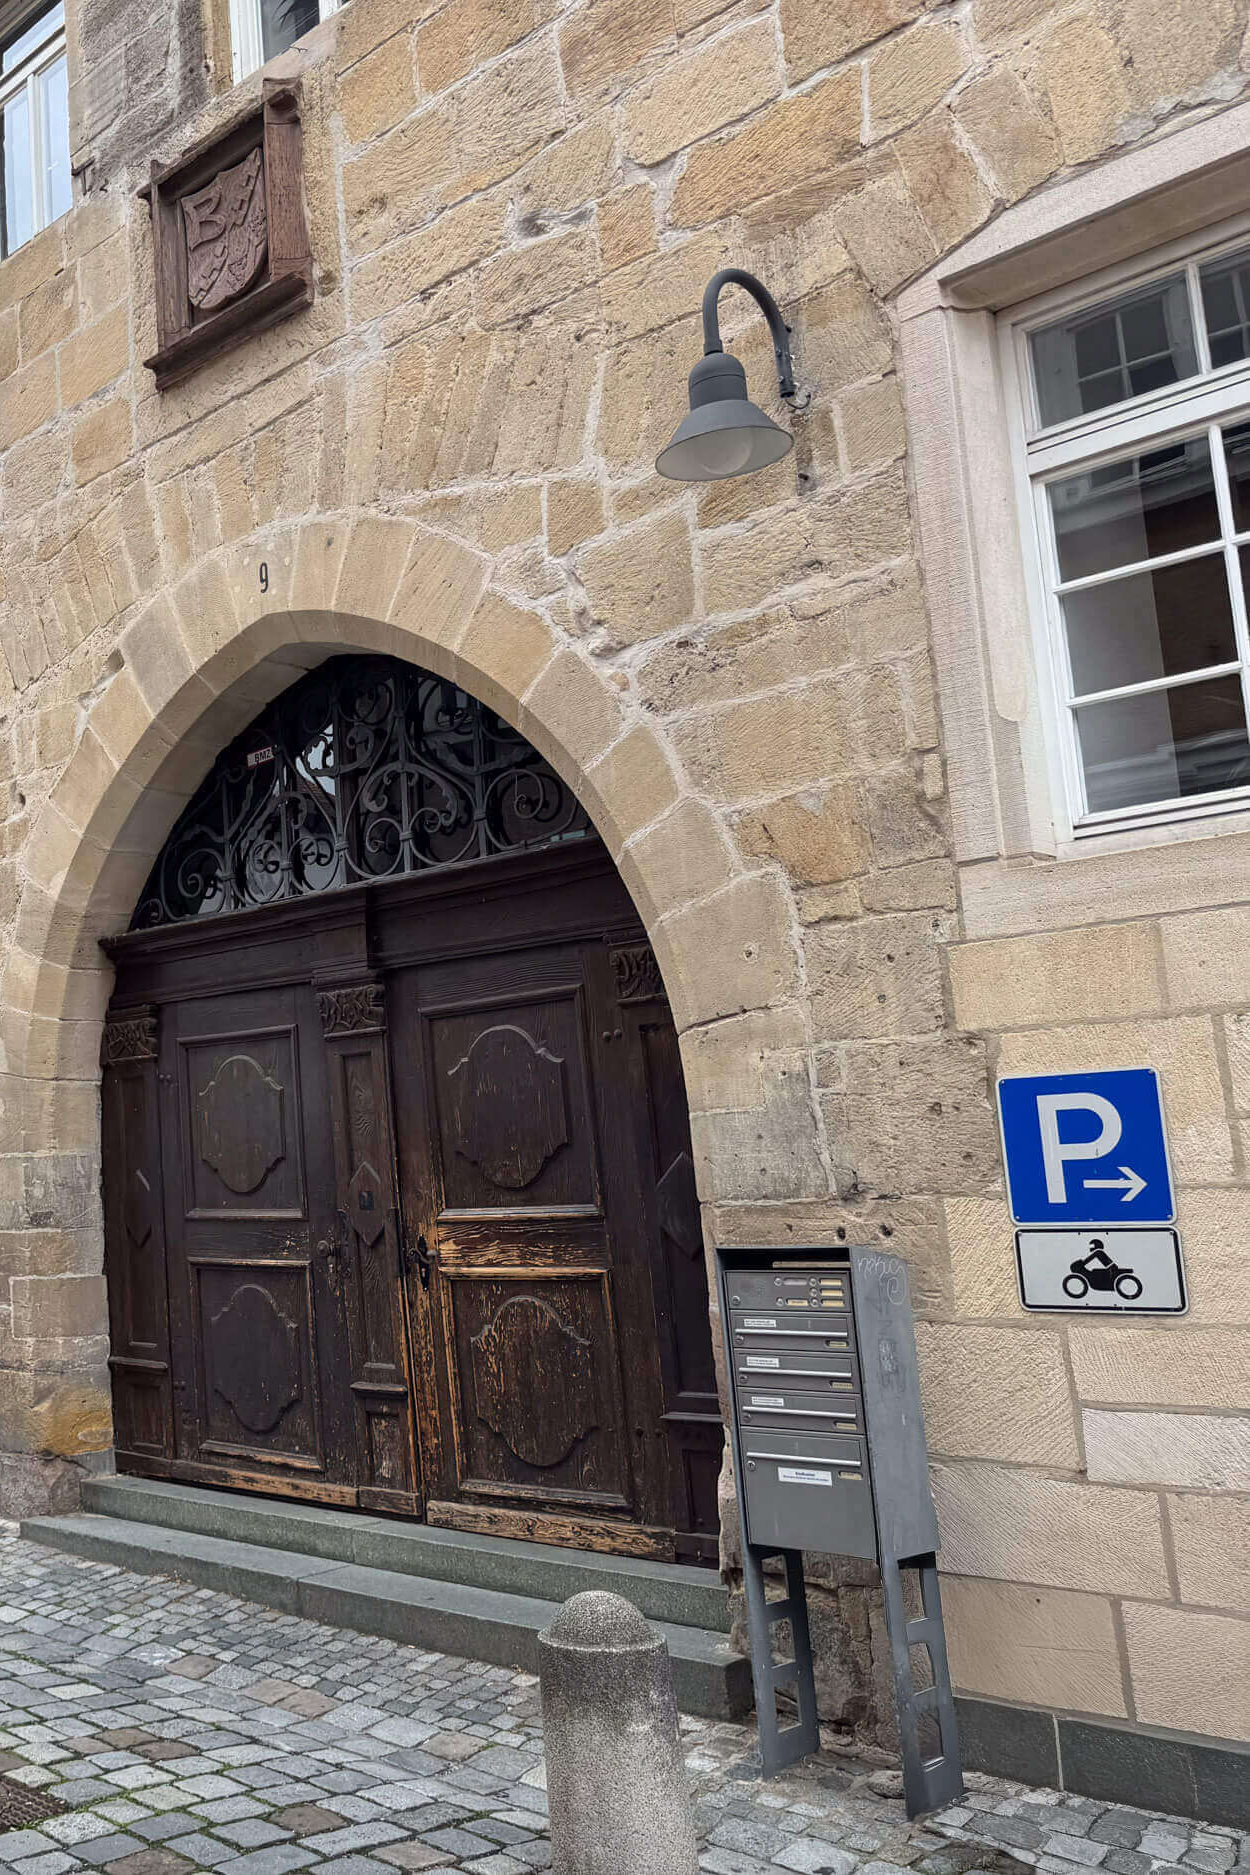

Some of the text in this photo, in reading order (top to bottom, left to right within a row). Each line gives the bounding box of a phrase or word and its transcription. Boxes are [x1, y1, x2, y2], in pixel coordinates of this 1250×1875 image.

[259, 561, 269, 594] 9
[254, 748, 271, 763] BMZ
[1036, 1092, 1123, 1204] P
